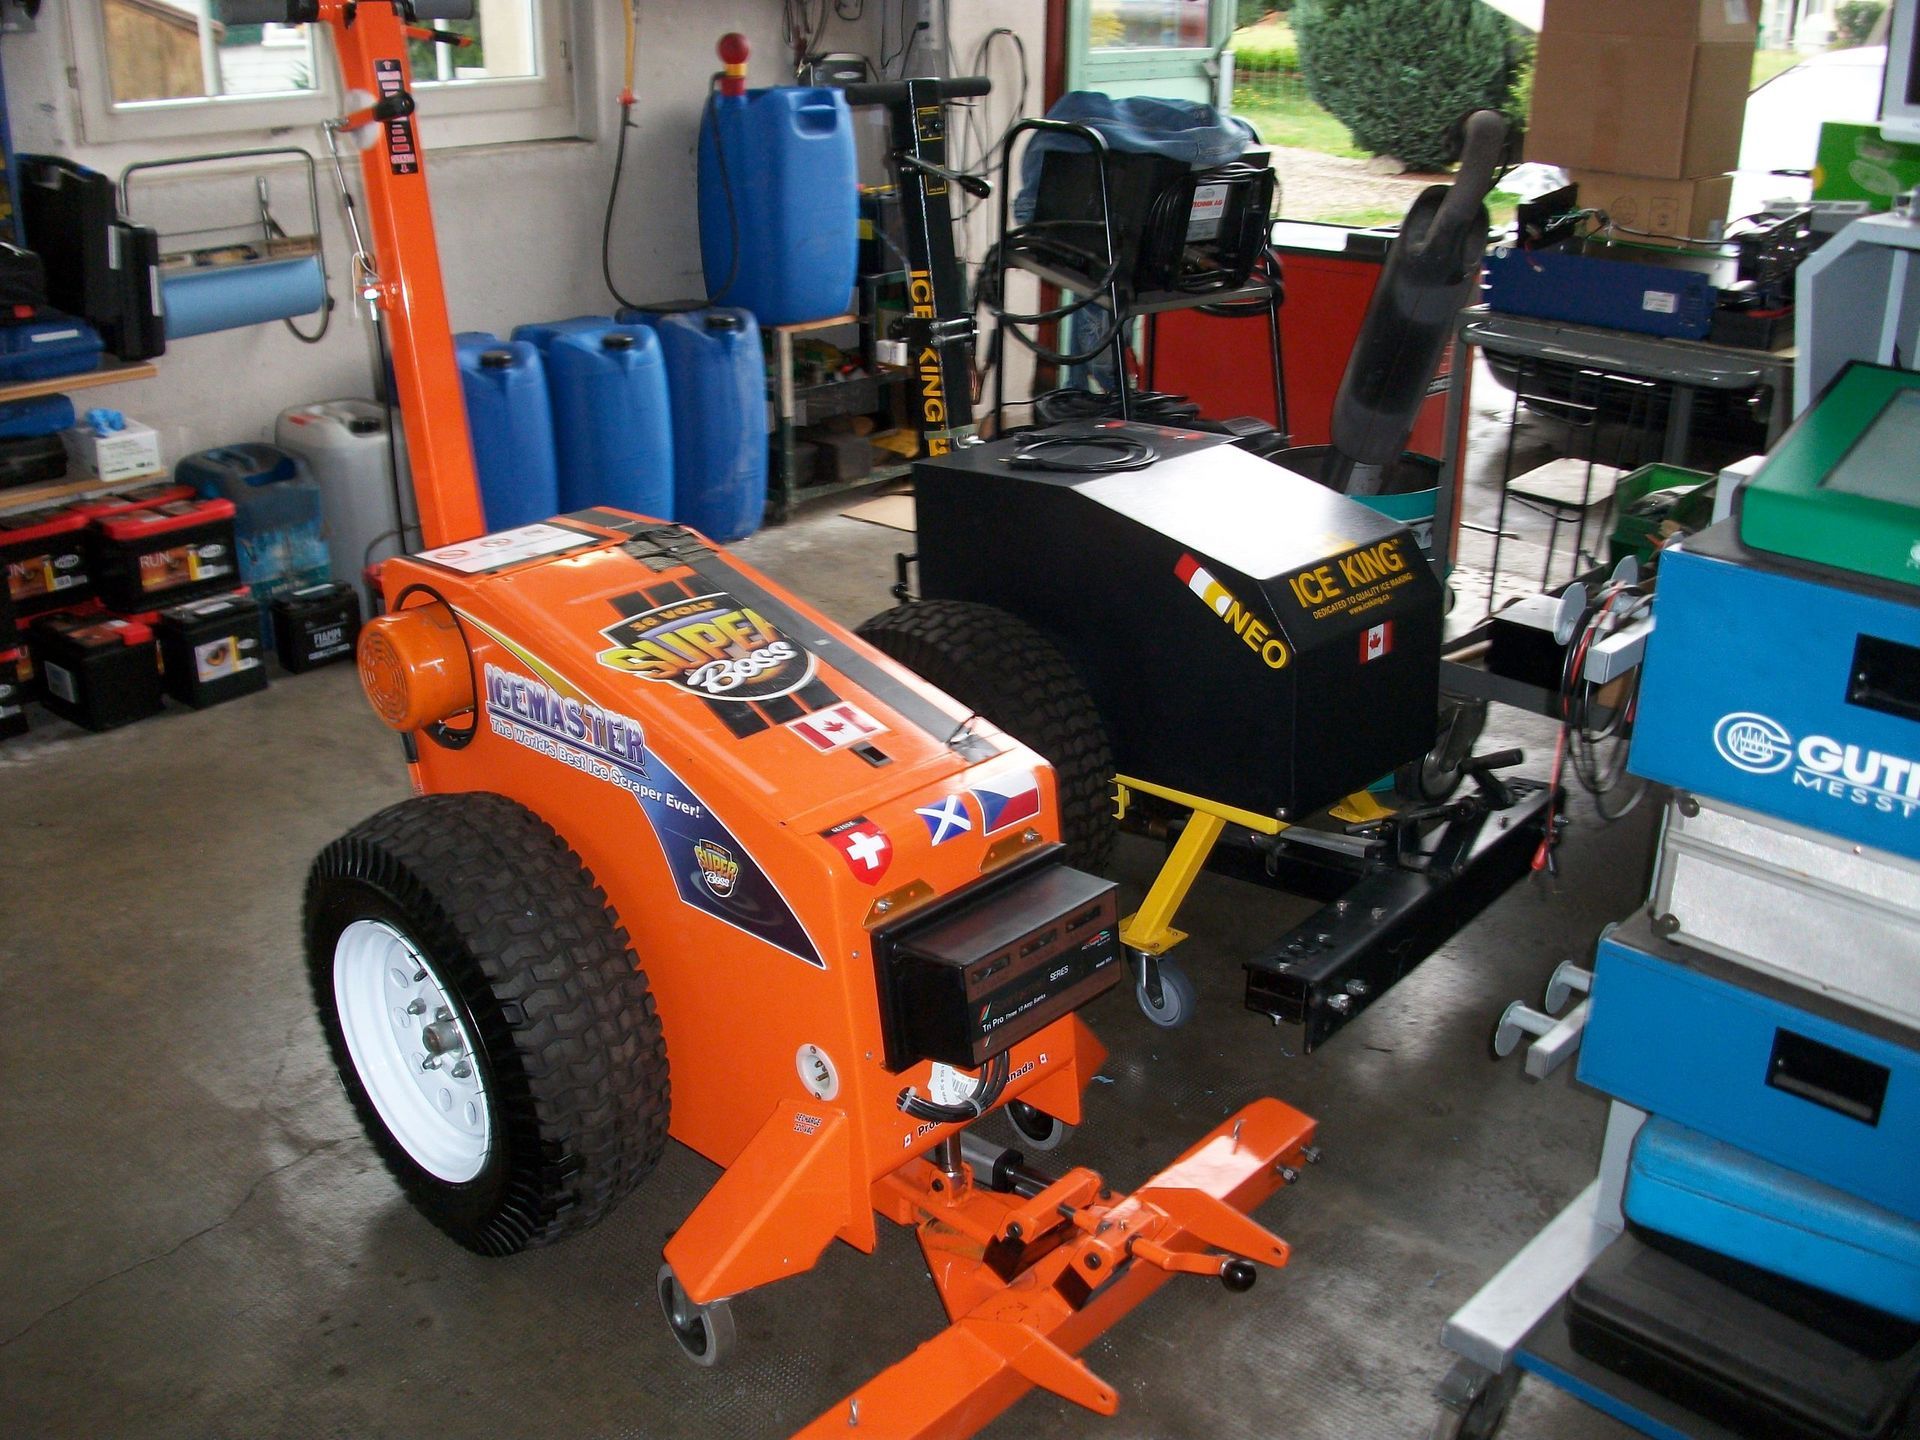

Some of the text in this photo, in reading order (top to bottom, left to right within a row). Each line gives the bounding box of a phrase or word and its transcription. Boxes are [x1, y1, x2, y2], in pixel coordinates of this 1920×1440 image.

[909, 270, 933, 318] ICE
[1289, 565, 1342, 609] ICE
[1312, 572, 1414, 620] DEDICATED TO QUALITY ICE MAKING
[663, 600, 717, 624] VOLT
[1223, 600, 1289, 669] NEO
[484, 663, 646, 766] ICEMASTER
[491, 717, 701, 819] The World's Best Ice Scraper Ever!
[1049, 964, 1070, 983] SERIES
[982, 1021, 993, 1033] Tri
[992, 1015, 1005, 1028] Pro
[795, 1112, 822, 1127] RECHARGE
